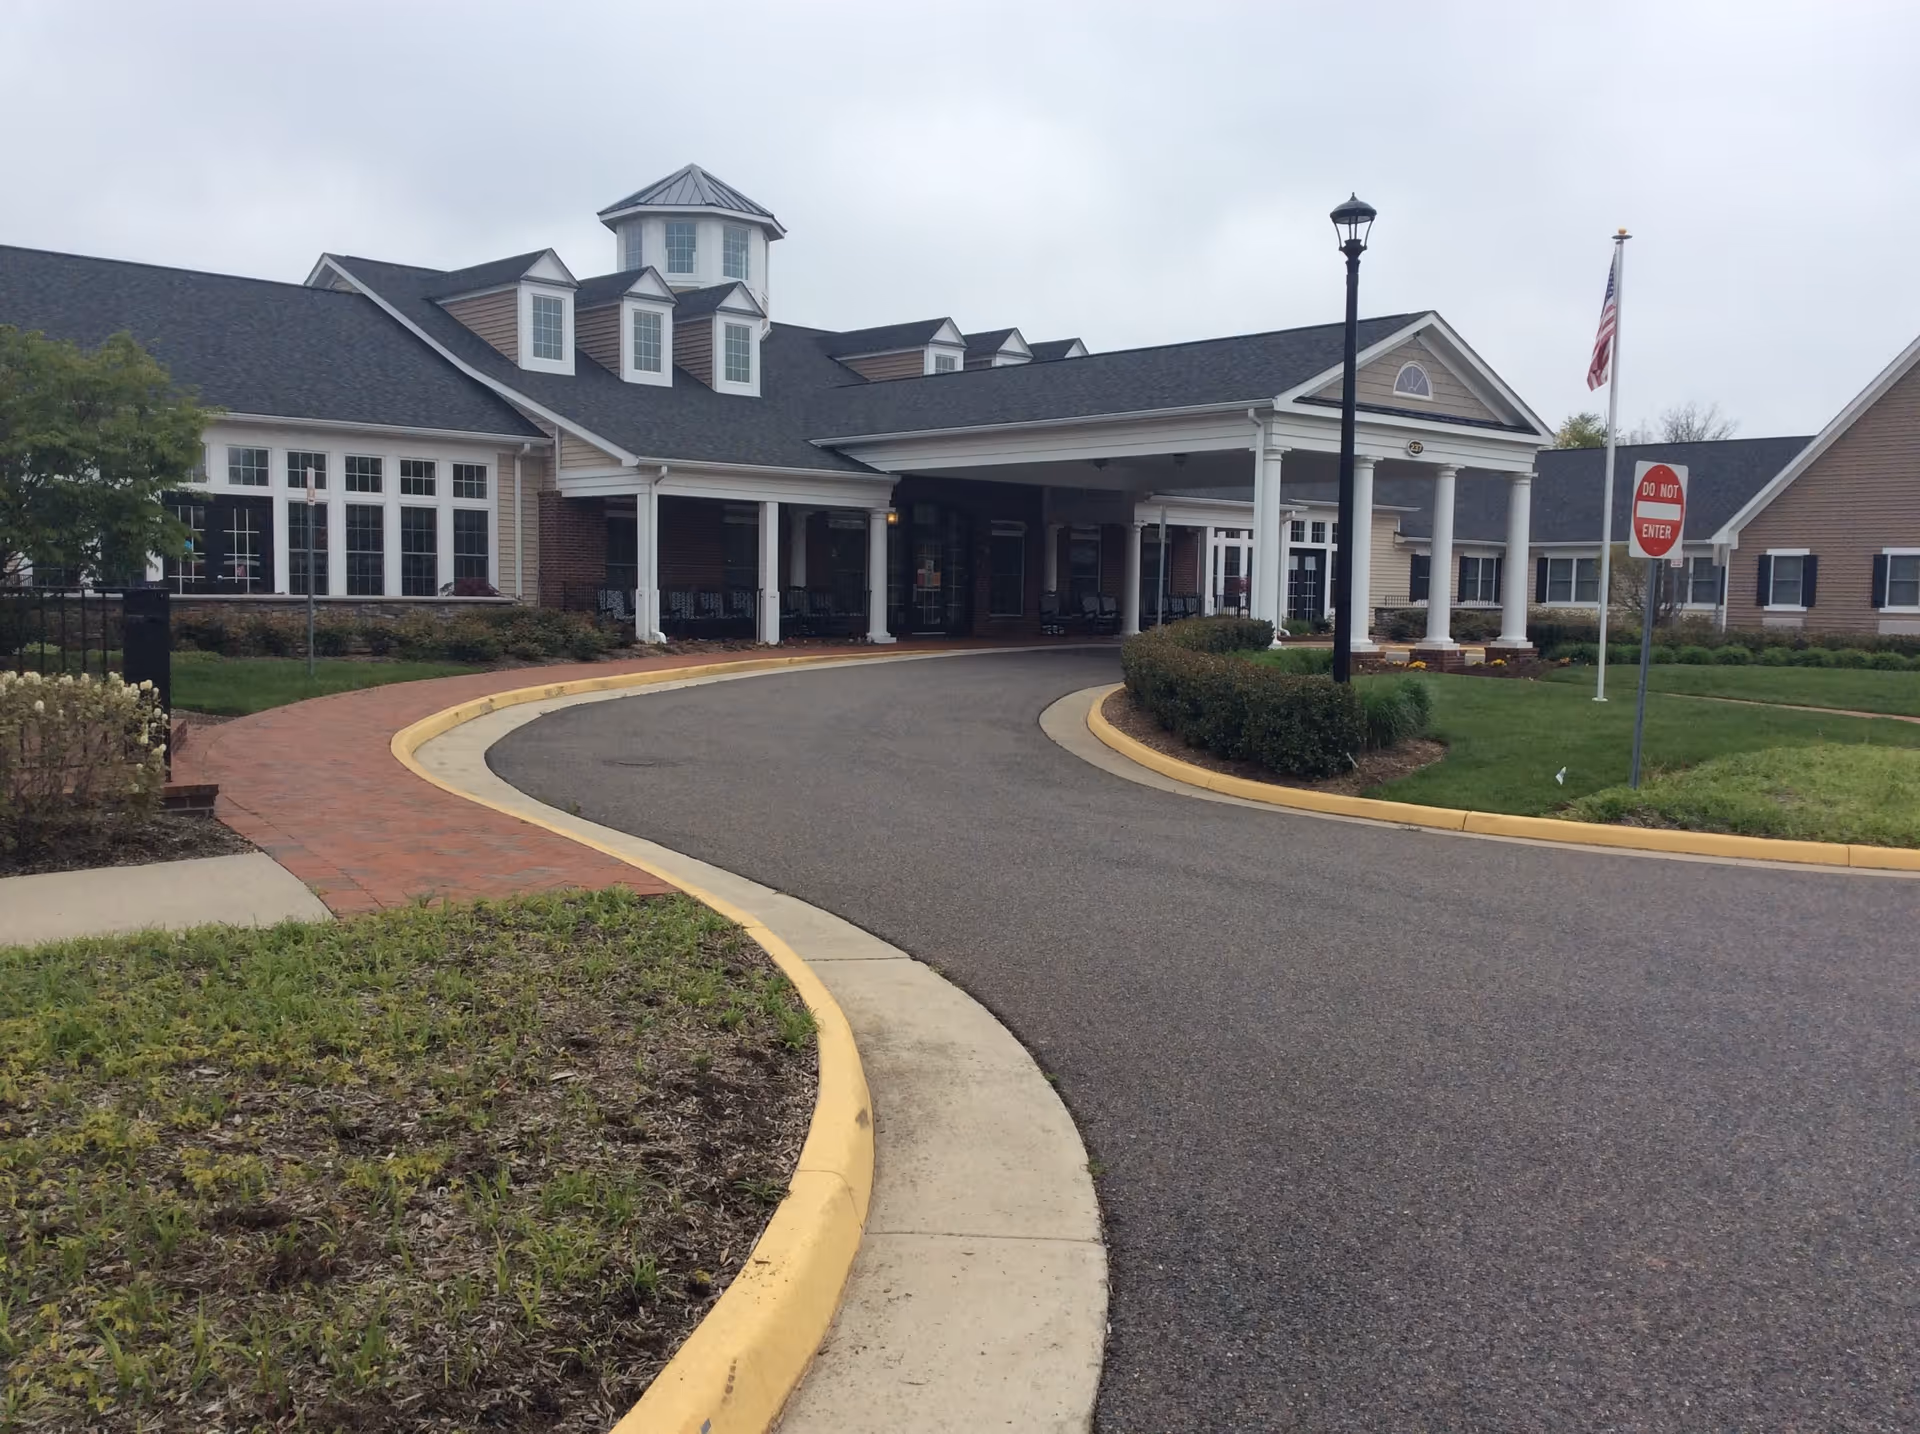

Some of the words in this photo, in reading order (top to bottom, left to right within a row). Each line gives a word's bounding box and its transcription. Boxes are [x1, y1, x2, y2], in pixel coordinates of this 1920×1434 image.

[1410, 443, 1422, 452] 237
[1642, 481, 1656, 497] DO
[1660, 483, 1679, 499] NOT
[1642, 523, 1672, 539] ENTER
